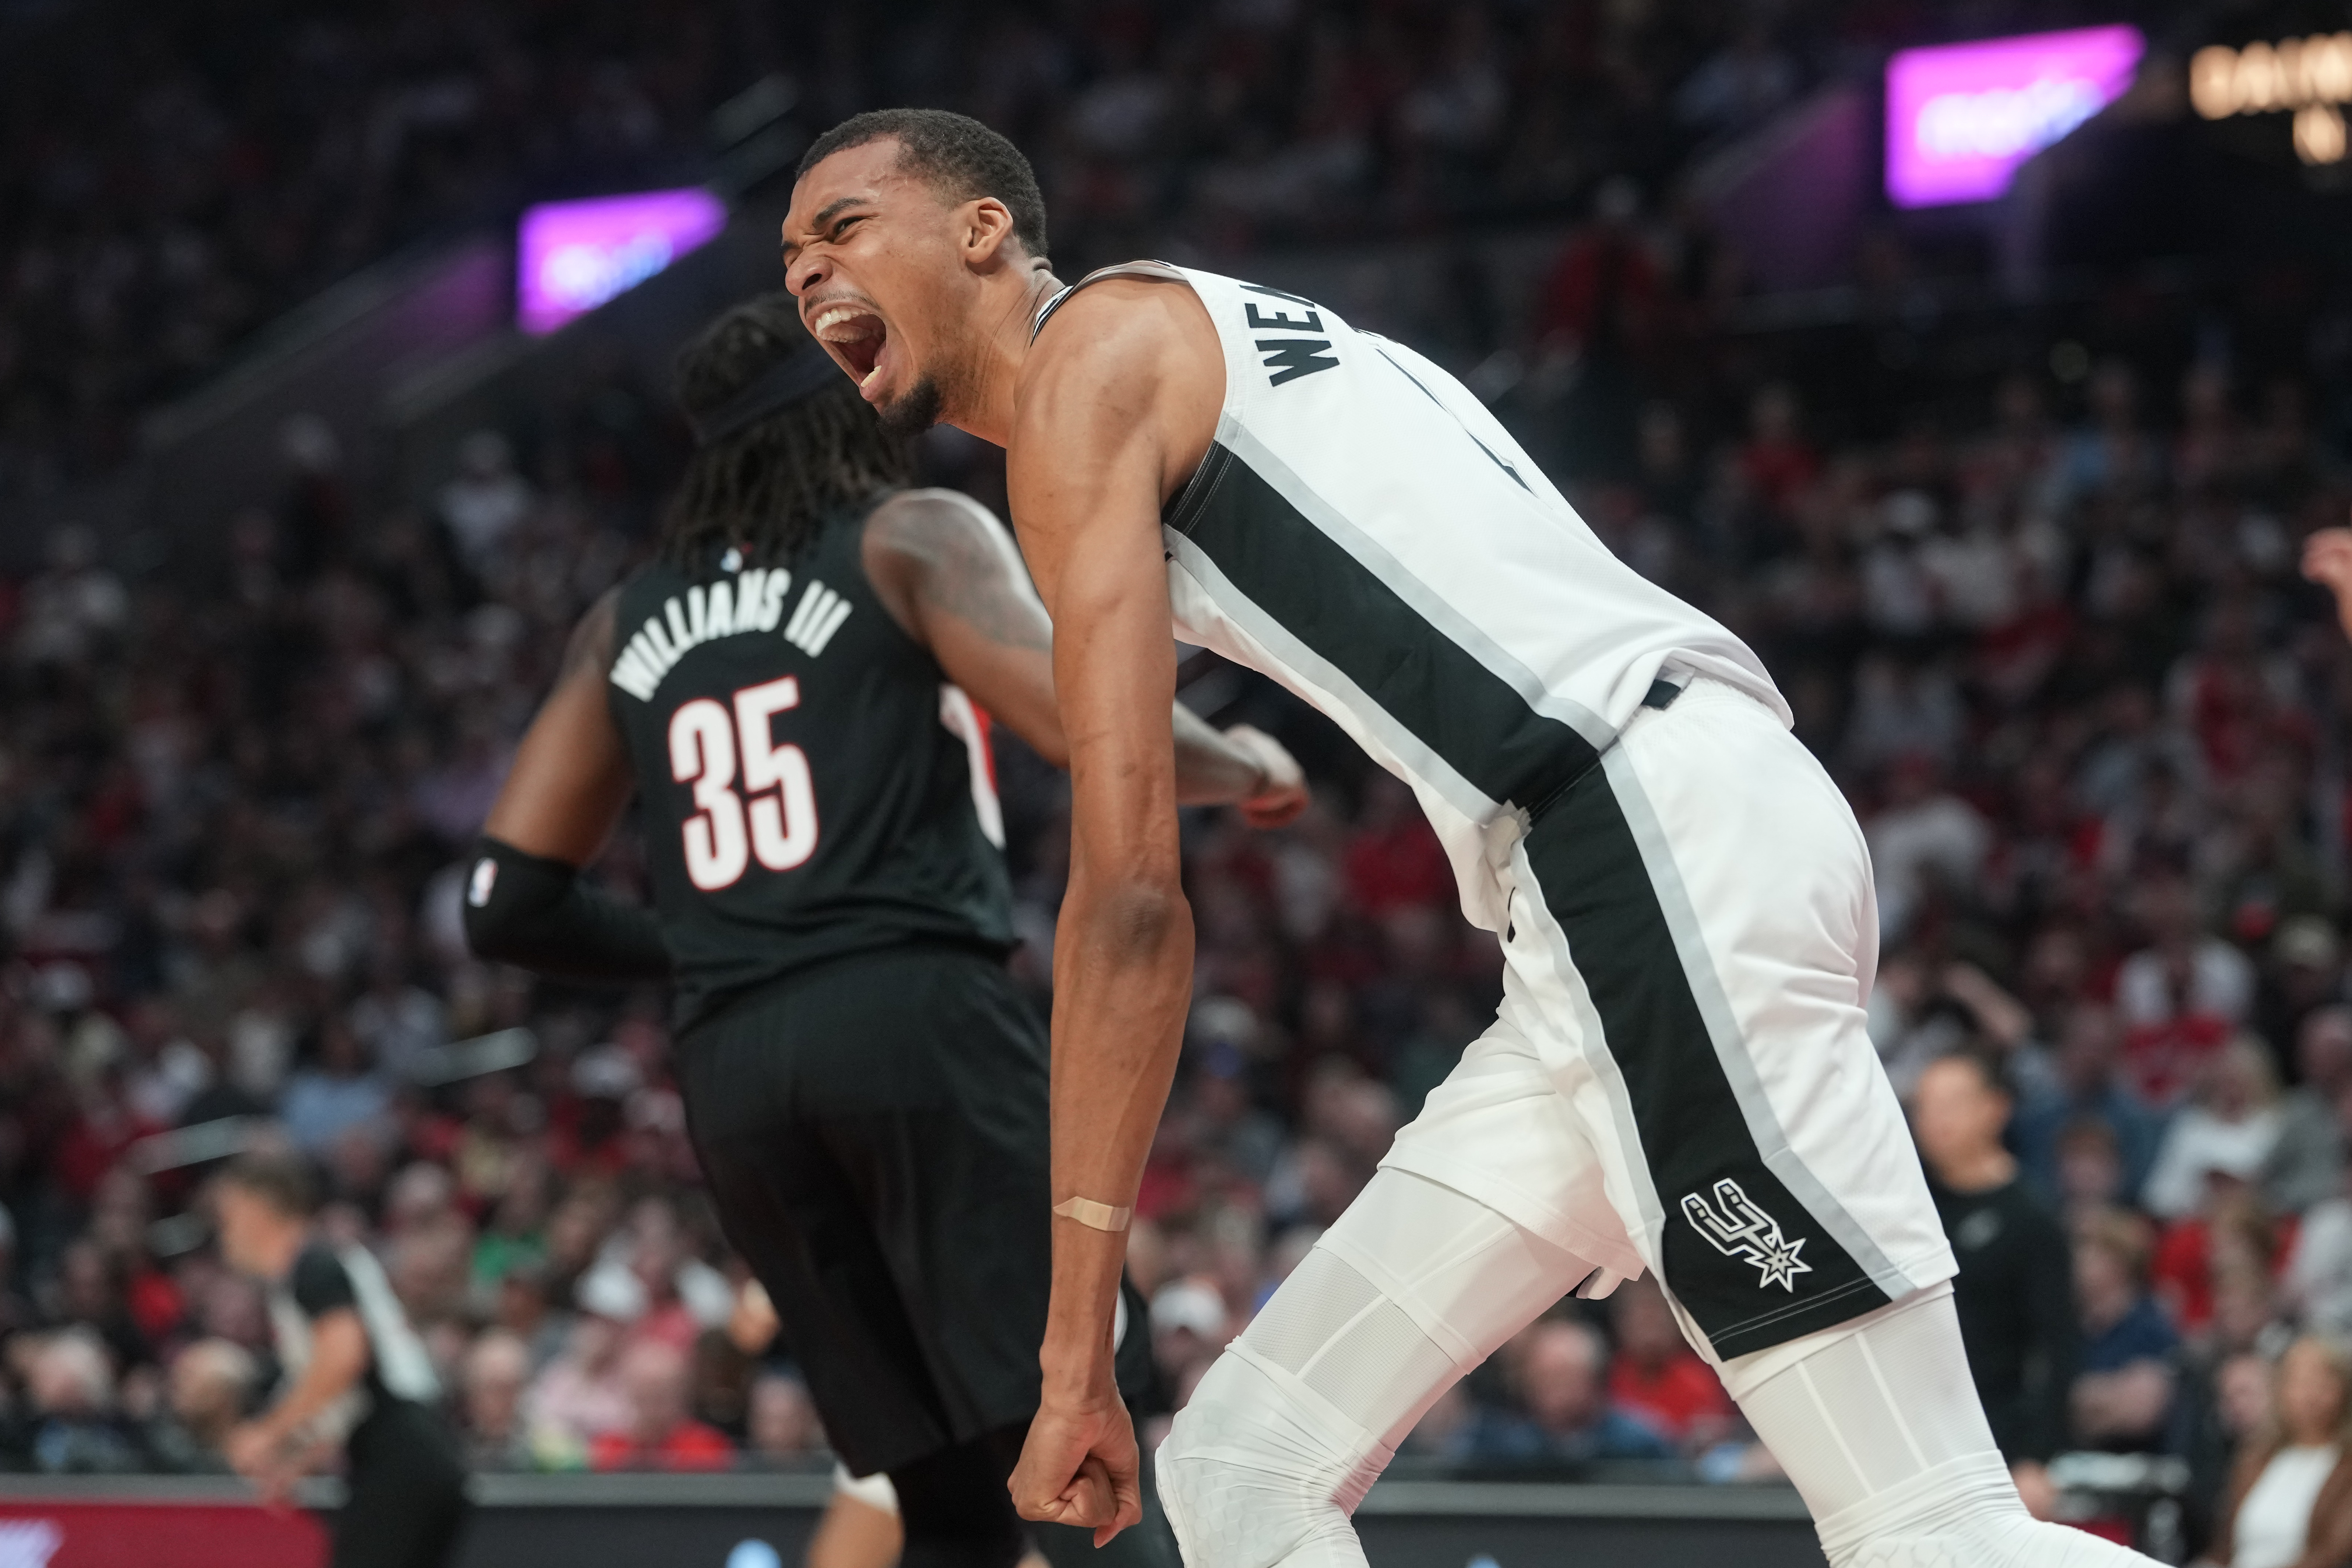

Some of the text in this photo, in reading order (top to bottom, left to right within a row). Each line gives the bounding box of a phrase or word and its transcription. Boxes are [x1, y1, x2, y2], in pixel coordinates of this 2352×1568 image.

[609, 567, 853, 702] WILLIAMS III
[667, 674, 820, 892] 35
